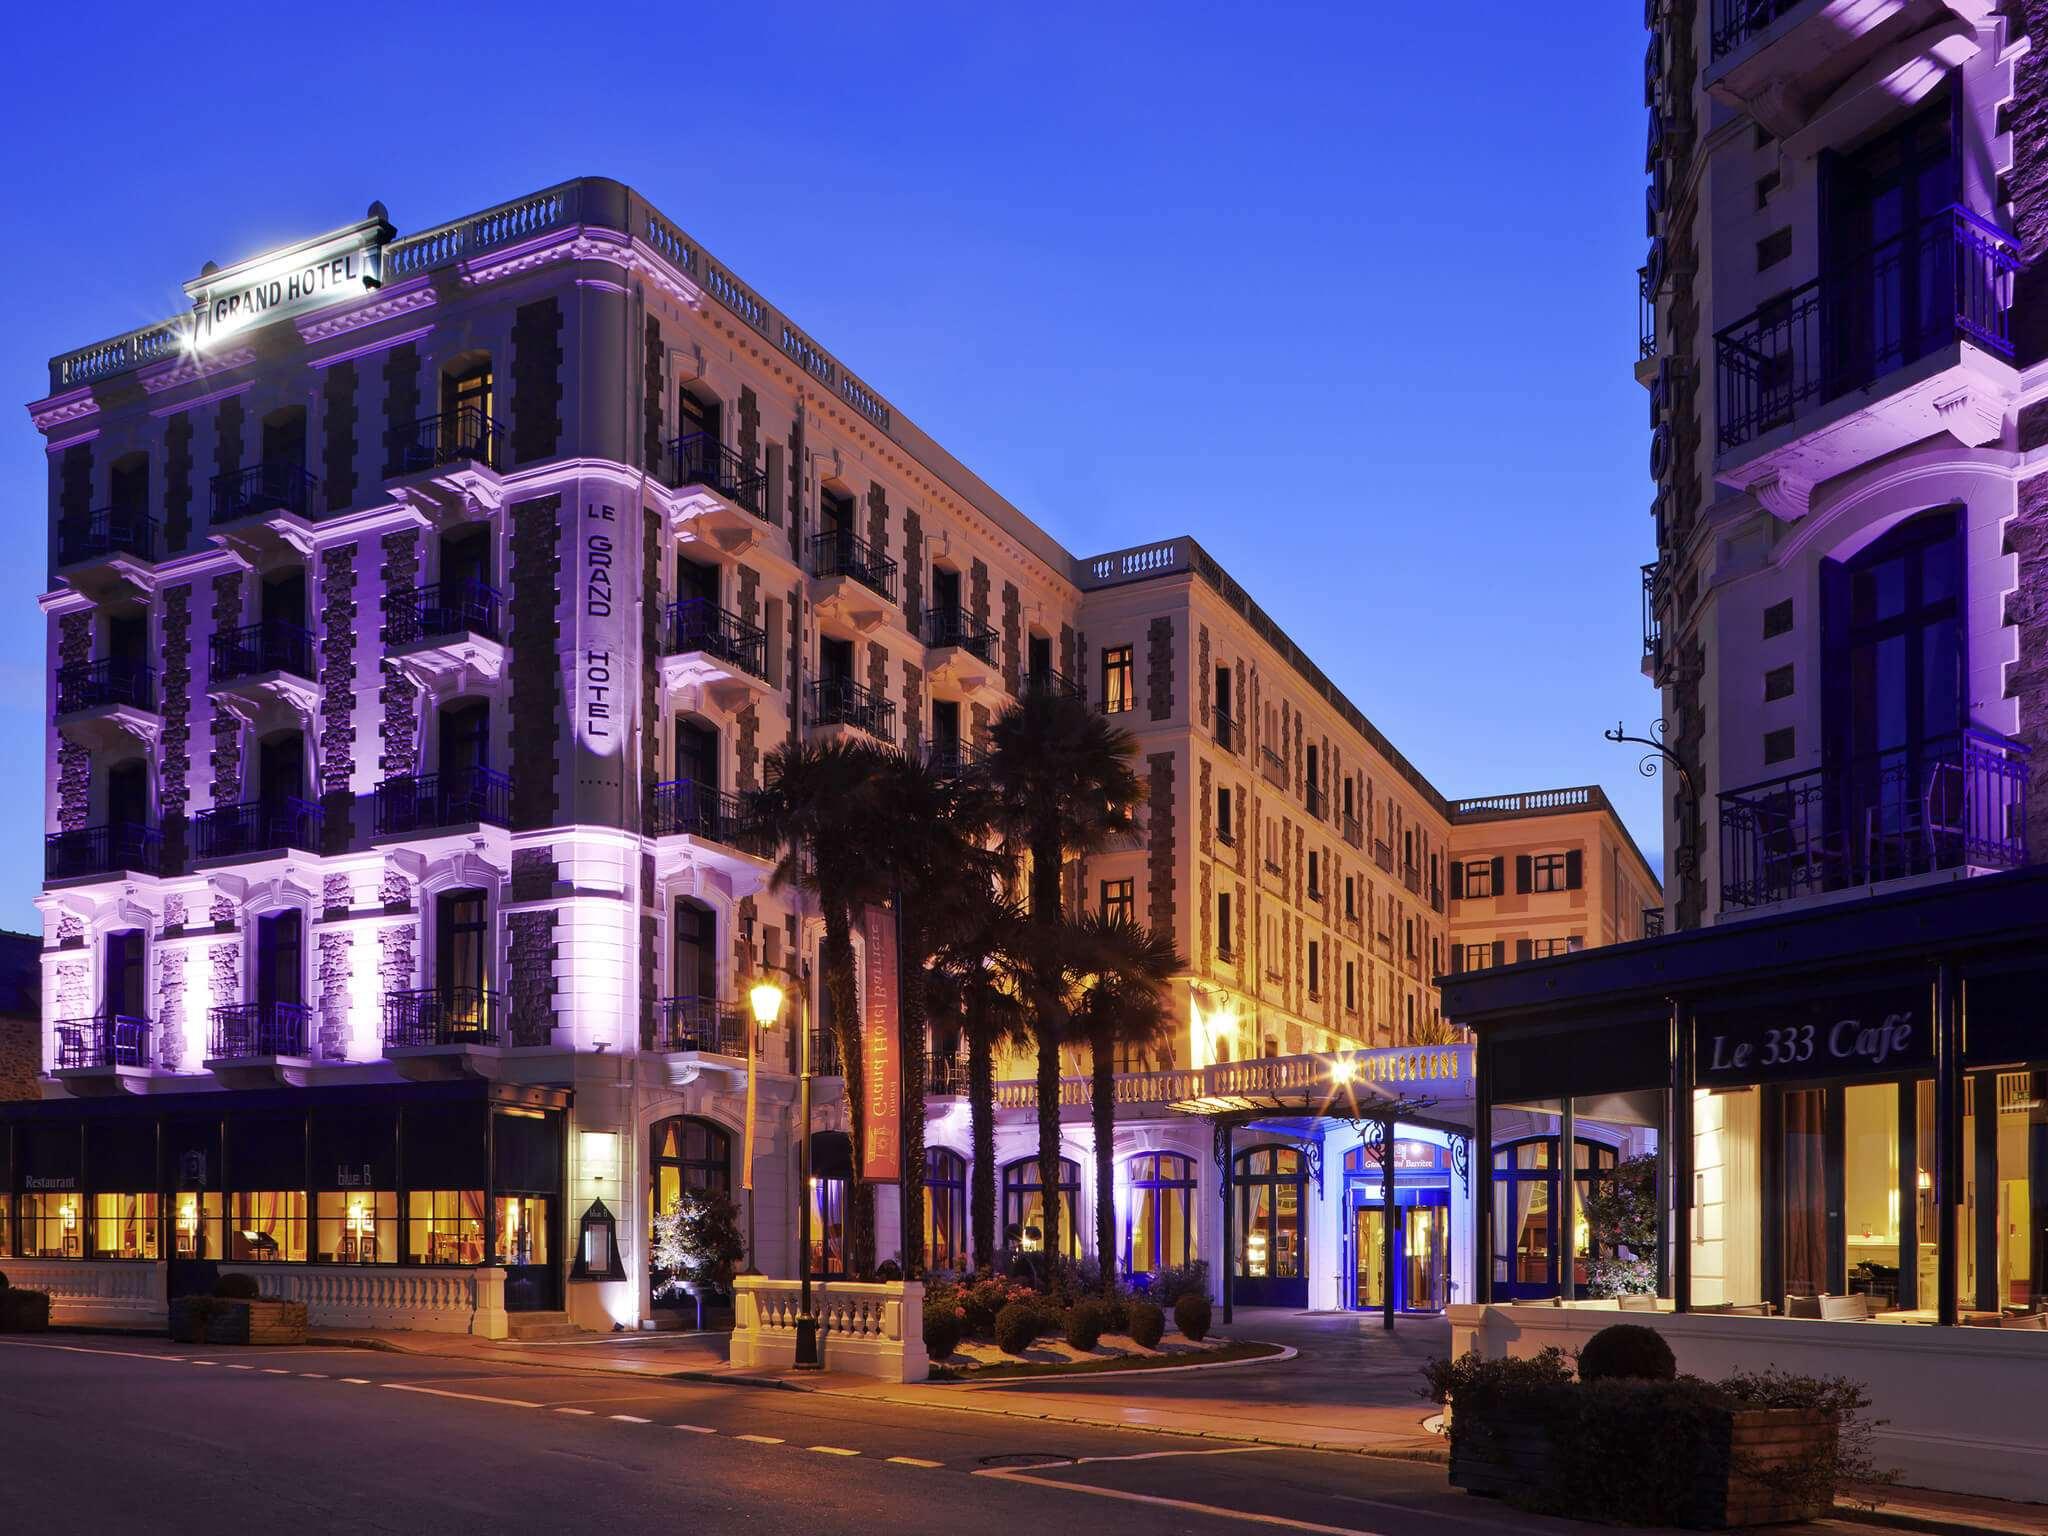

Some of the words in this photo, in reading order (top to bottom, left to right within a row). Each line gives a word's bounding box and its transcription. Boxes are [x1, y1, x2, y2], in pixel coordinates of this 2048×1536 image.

[215, 281, 282, 323] GRAND
[288, 256, 357, 300] HOTEL
[588, 503, 616, 522] LE
[587, 535, 613, 618] GRAND
[587, 651, 610, 737] HOTEL
[1709, 1035, 1752, 1071] Le
[1761, 1024, 1816, 1066] 333
[1828, 1011, 1913, 1064] Café
[25, 1175, 75, 1189] Restaurant
[363, 1163, 371, 1185] B
